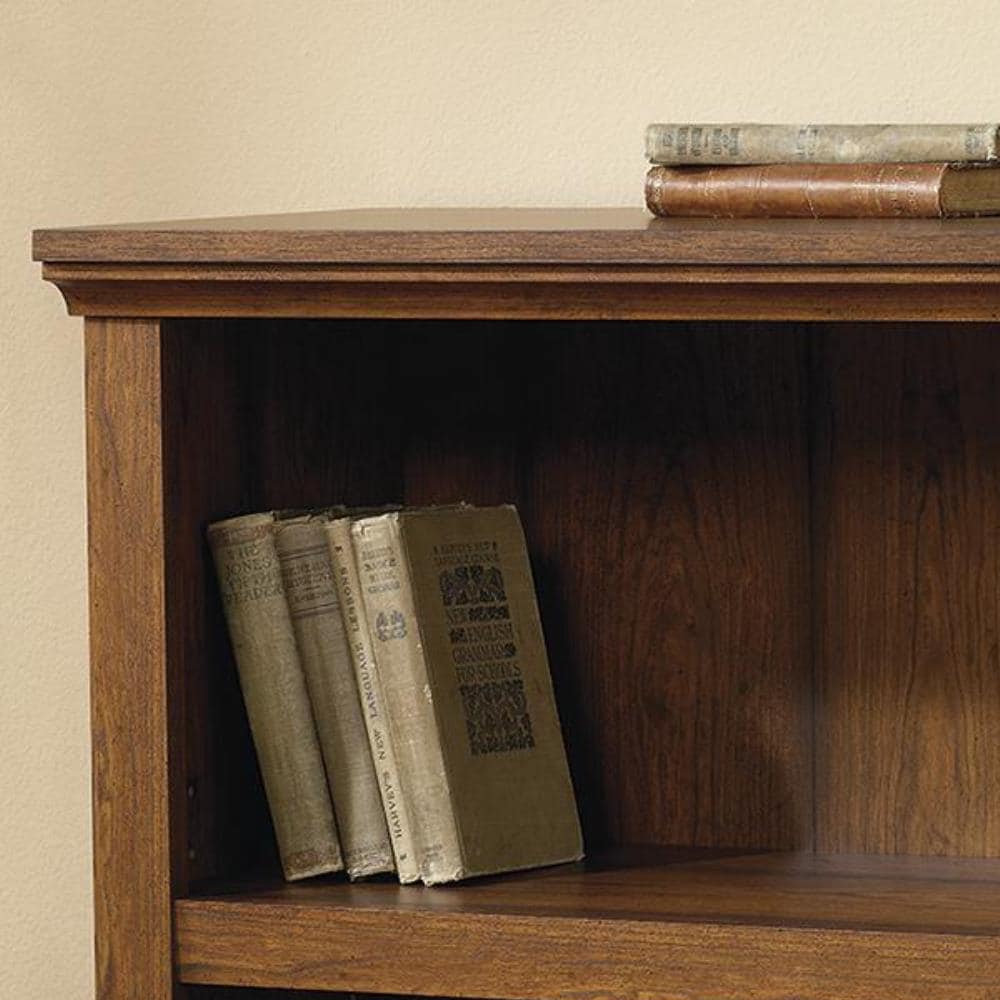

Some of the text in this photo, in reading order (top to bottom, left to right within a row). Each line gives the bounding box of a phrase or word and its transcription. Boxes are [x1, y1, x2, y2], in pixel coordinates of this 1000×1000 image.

[341, 566, 360, 633] LESSONS
[355, 642, 378, 719] LANGUAGE
[373, 726, 386, 761] NEW
